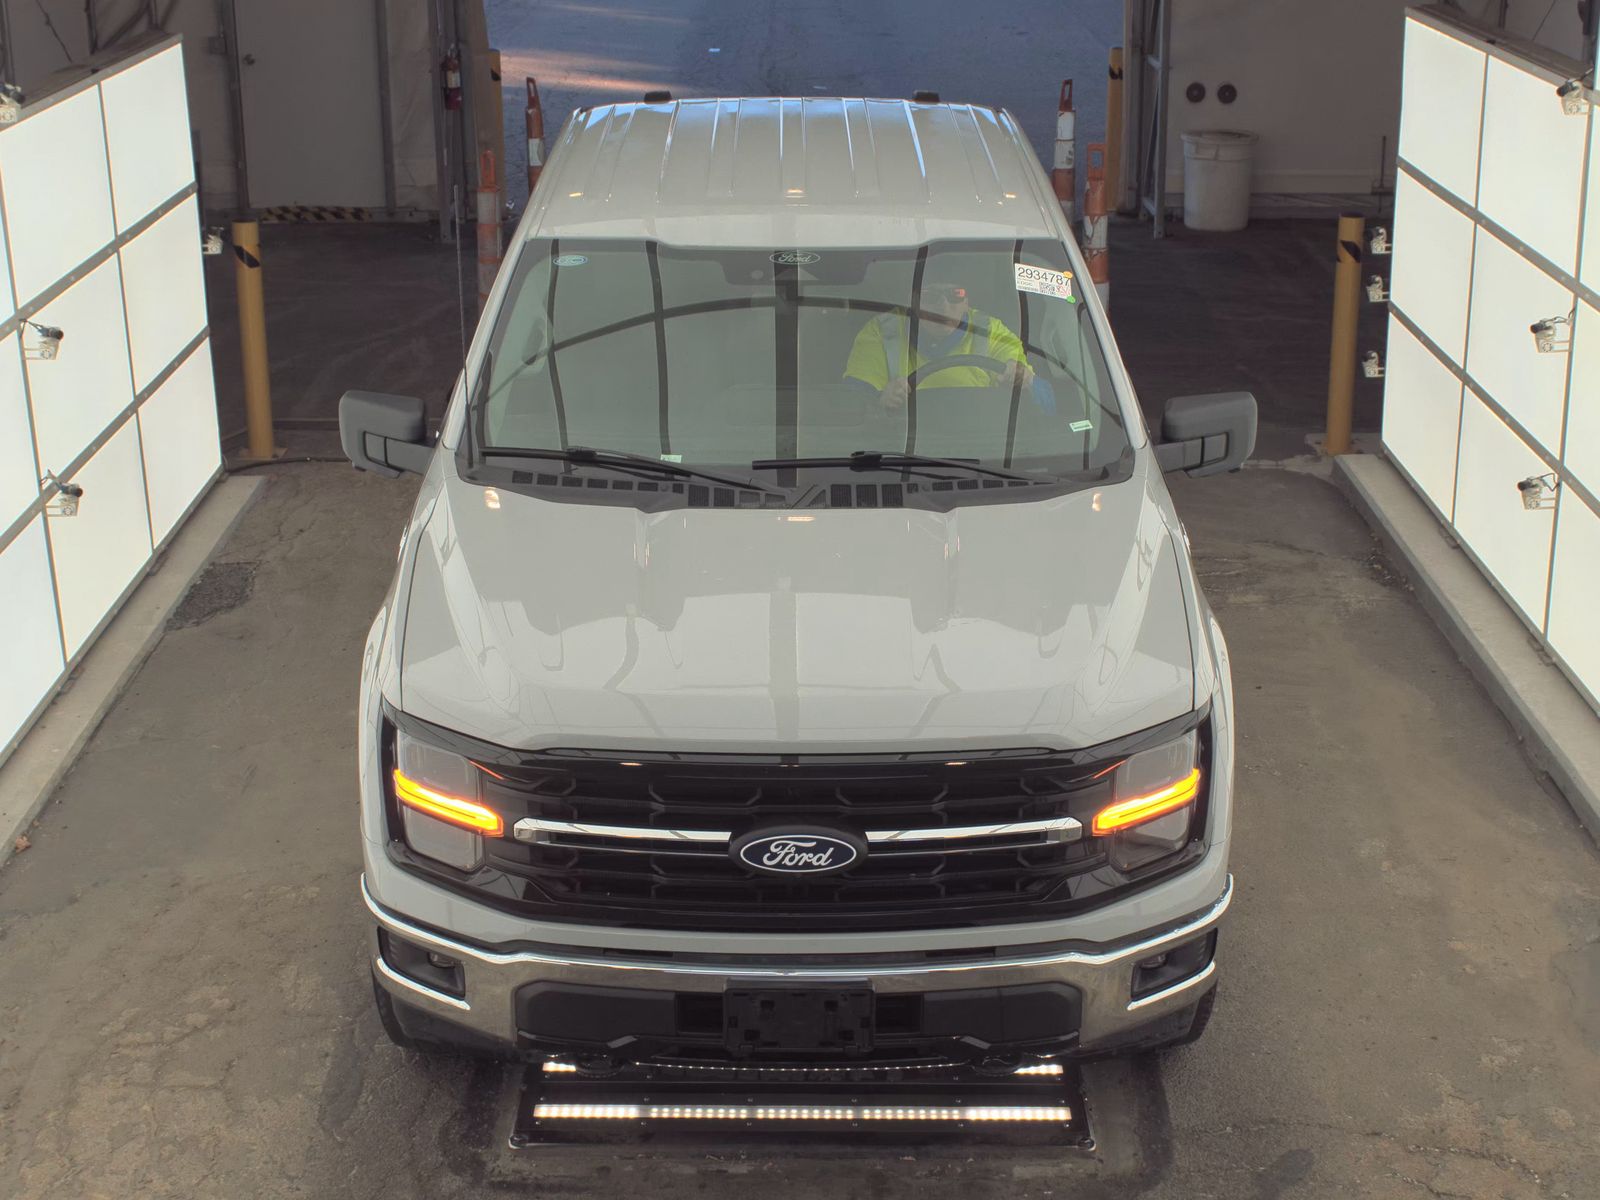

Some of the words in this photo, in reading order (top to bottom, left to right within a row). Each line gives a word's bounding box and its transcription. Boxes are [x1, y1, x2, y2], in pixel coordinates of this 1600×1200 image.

[779, 252, 812, 263] Ford
[1018, 267, 1070, 286] 2934787
[762, 840, 834, 866] Ford
